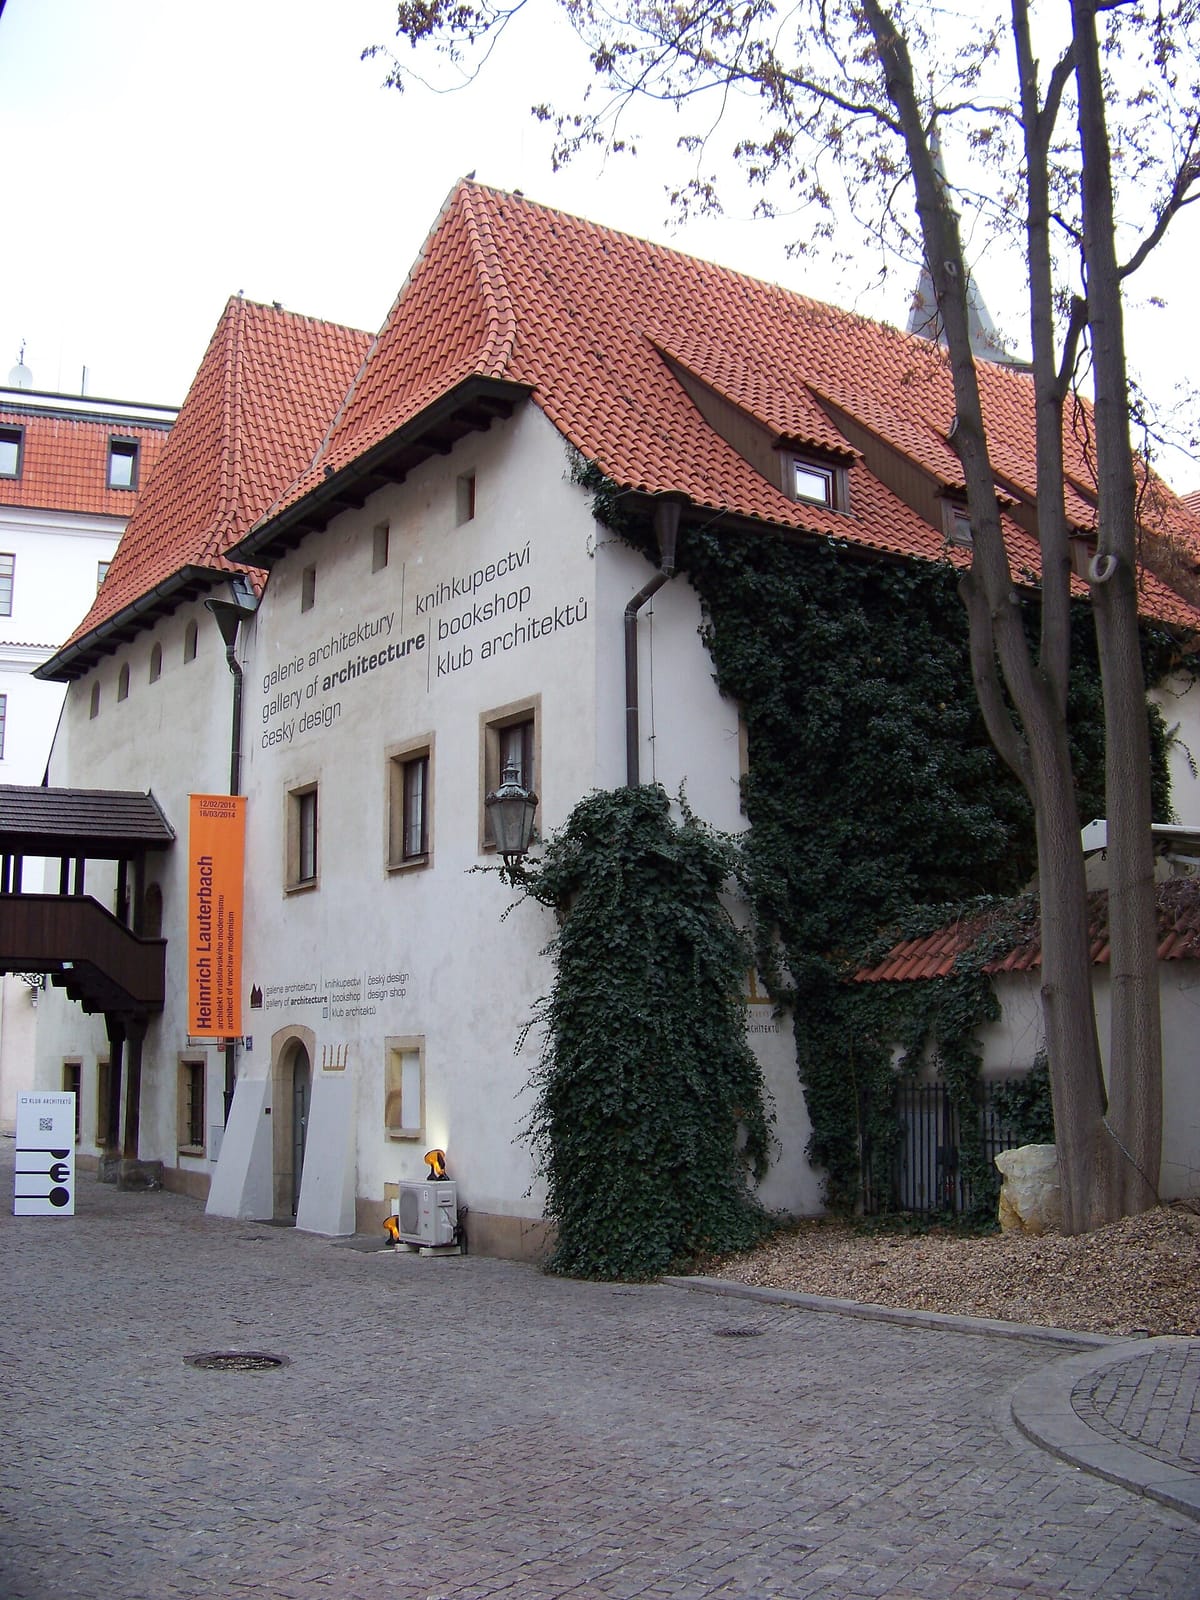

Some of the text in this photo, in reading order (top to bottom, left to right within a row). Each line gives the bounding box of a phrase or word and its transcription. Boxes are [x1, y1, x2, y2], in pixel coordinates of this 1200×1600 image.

[415, 540, 532, 616] knihkupectví
[438, 584, 532, 641] bookshop
[263, 611, 395, 694] galerie architektury
[437, 596, 588, 678] klub architektů
[262, 632, 426, 724] gallery of architecture
[261, 700, 342, 749] český design
[200, 800, 236, 808] 12/02/2014
[196, 856, 212, 1029] Heinrich Lauterbach
[226, 911, 234, 953] modernism
[226, 987, 234, 996] of
[332, 992, 361, 1003] bookshop
[367, 987, 406, 1001] design shop
[386, 972, 409, 984] design
[226, 998, 234, 1029] architect
[291, 995, 328, 1006] architecture
